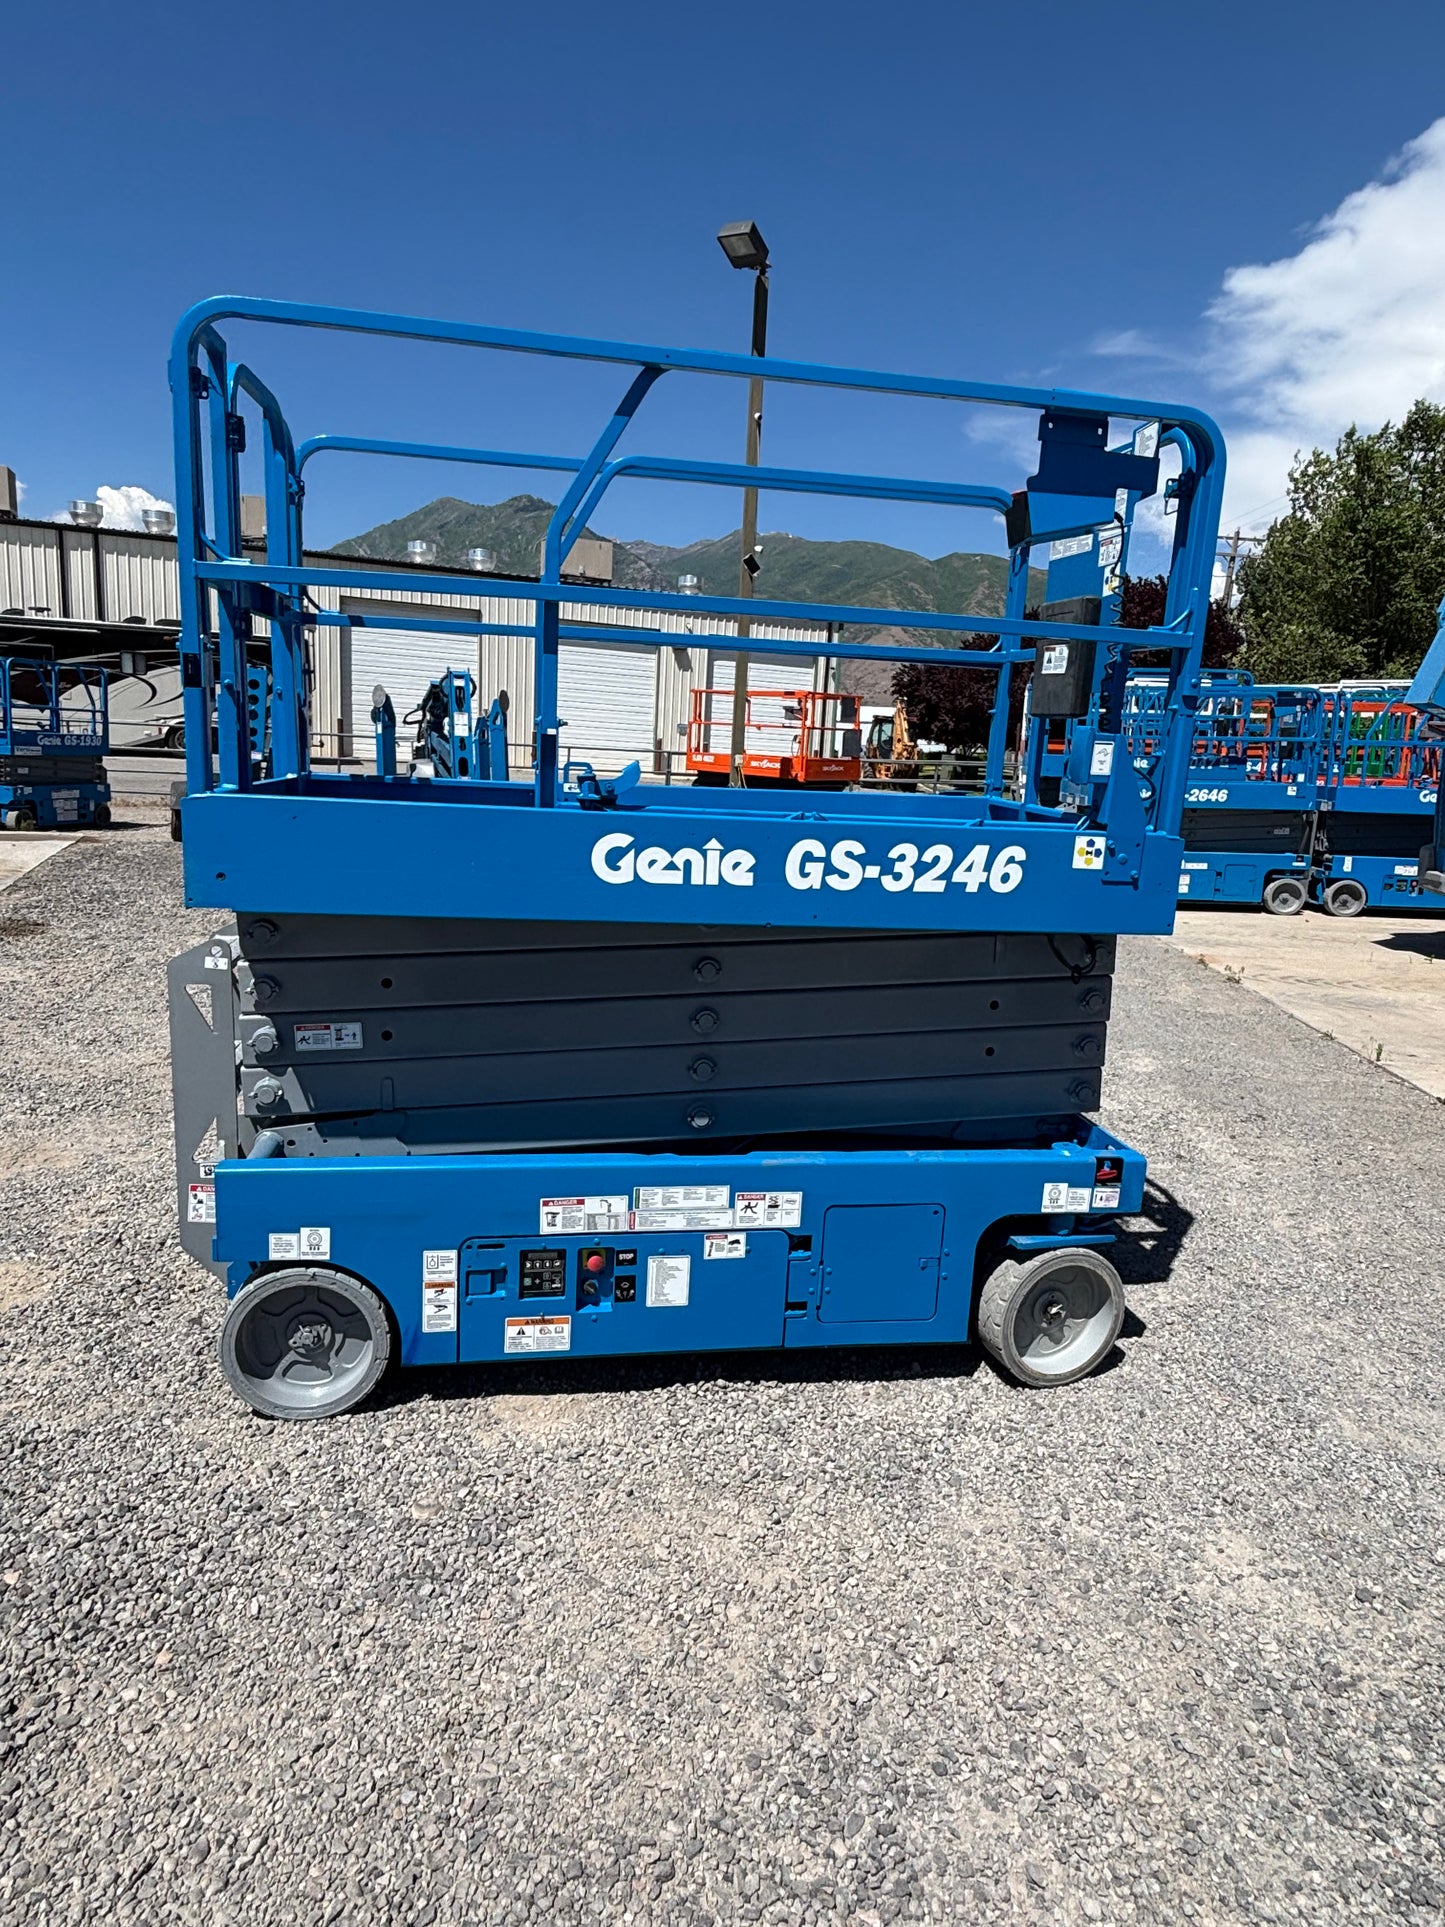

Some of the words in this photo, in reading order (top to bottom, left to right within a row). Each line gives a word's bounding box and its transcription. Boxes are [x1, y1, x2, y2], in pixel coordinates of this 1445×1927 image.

[37, 735, 62, 745] Genie
[64, 735, 102, 746] GS-1930
[750, 759, 781, 769] SKYJACK
[822, 764, 844, 772] SKYJACK
[1184, 789, 1228, 803] -2646
[591, 833, 756, 886] Genie
[786, 840, 1027, 893] GS-3246
[618, 1253, 634, 1261] STOP
